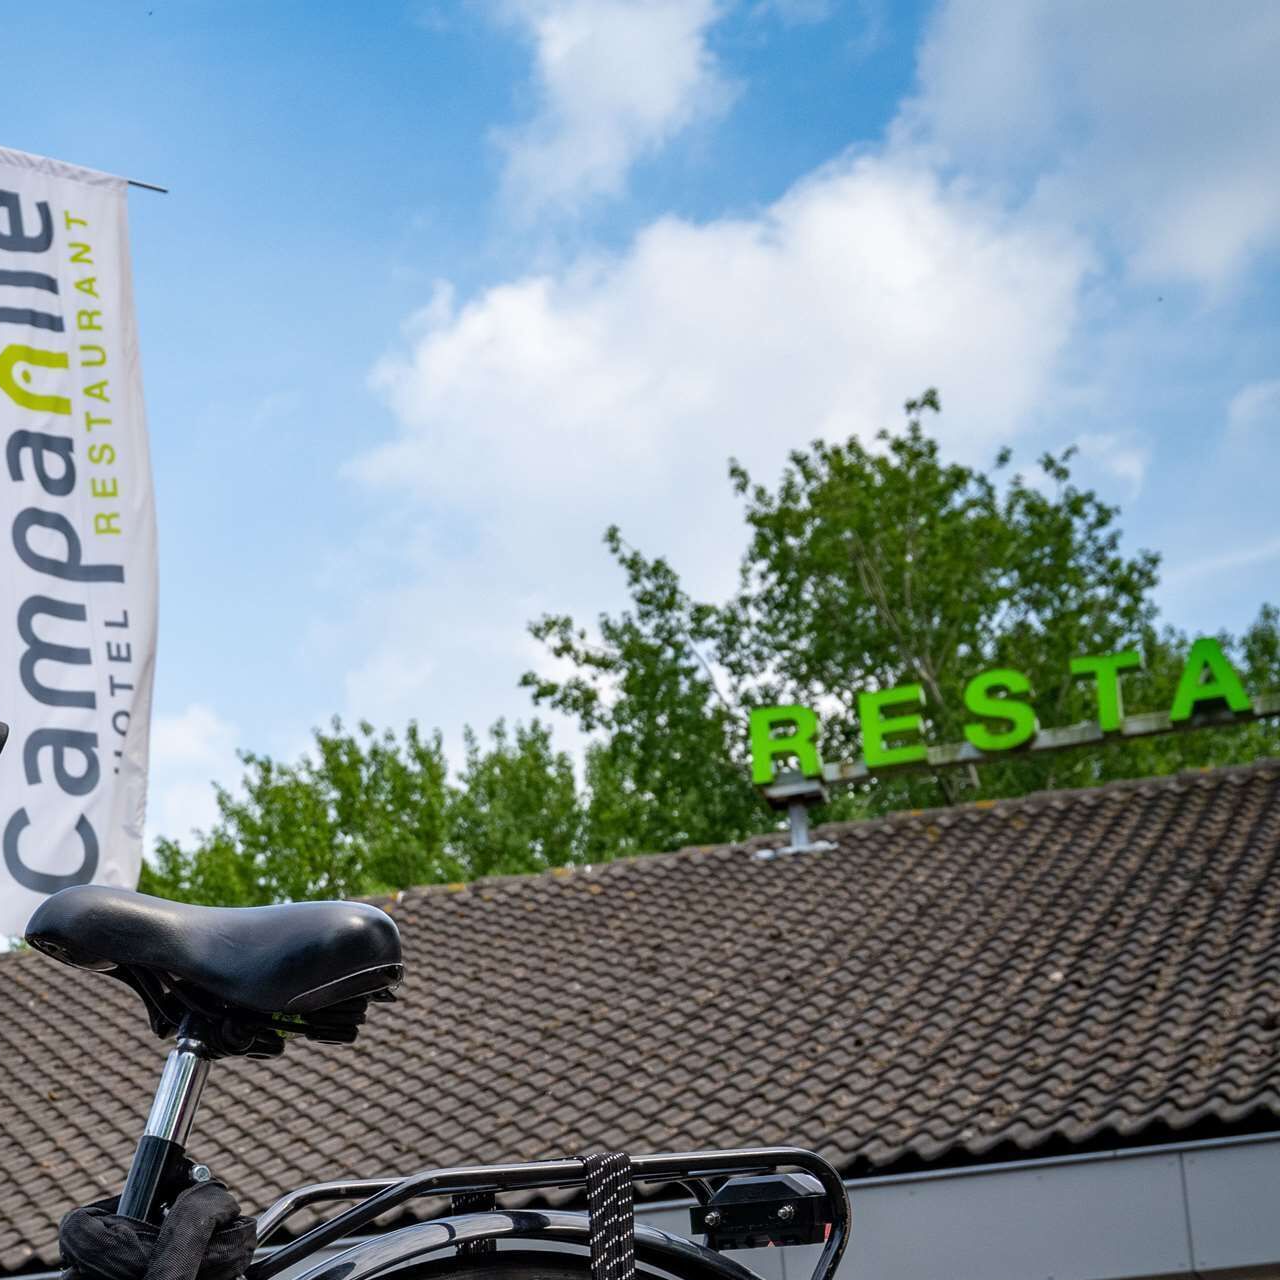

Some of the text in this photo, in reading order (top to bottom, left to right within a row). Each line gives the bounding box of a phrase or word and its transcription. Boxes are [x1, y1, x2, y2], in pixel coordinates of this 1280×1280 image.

[64, 210, 134, 774] OTEL RESTAURANT
[750, 637, 1251, 785] RESTA
